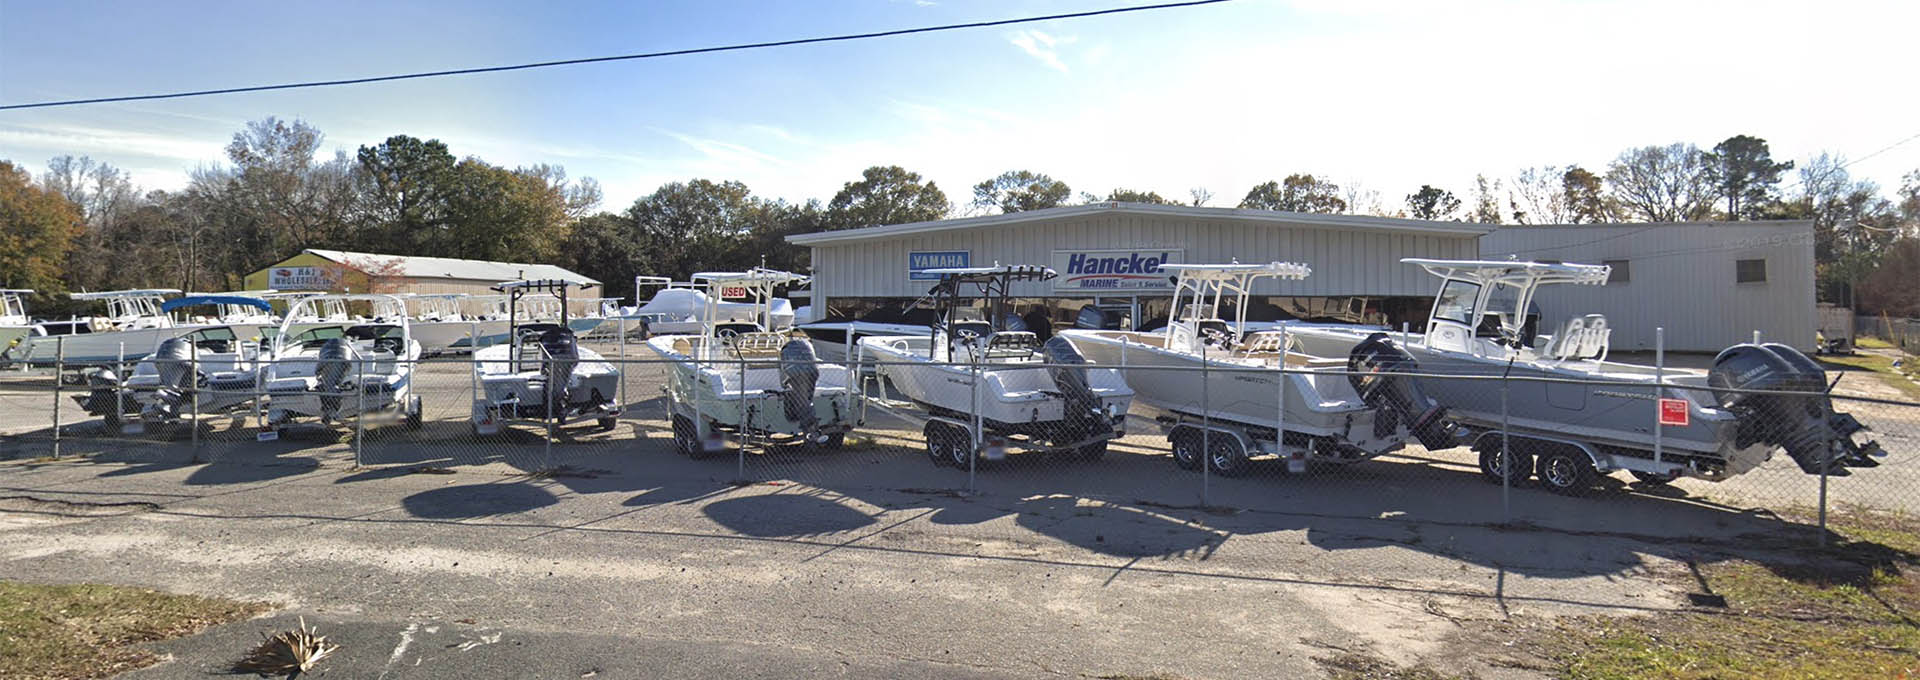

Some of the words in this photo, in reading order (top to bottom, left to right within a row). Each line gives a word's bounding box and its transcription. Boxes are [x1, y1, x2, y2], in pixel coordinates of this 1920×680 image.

[913, 255, 964, 268] YAMAHA
[1080, 279, 1119, 288] MARINE
[722, 287, 744, 296] USED
